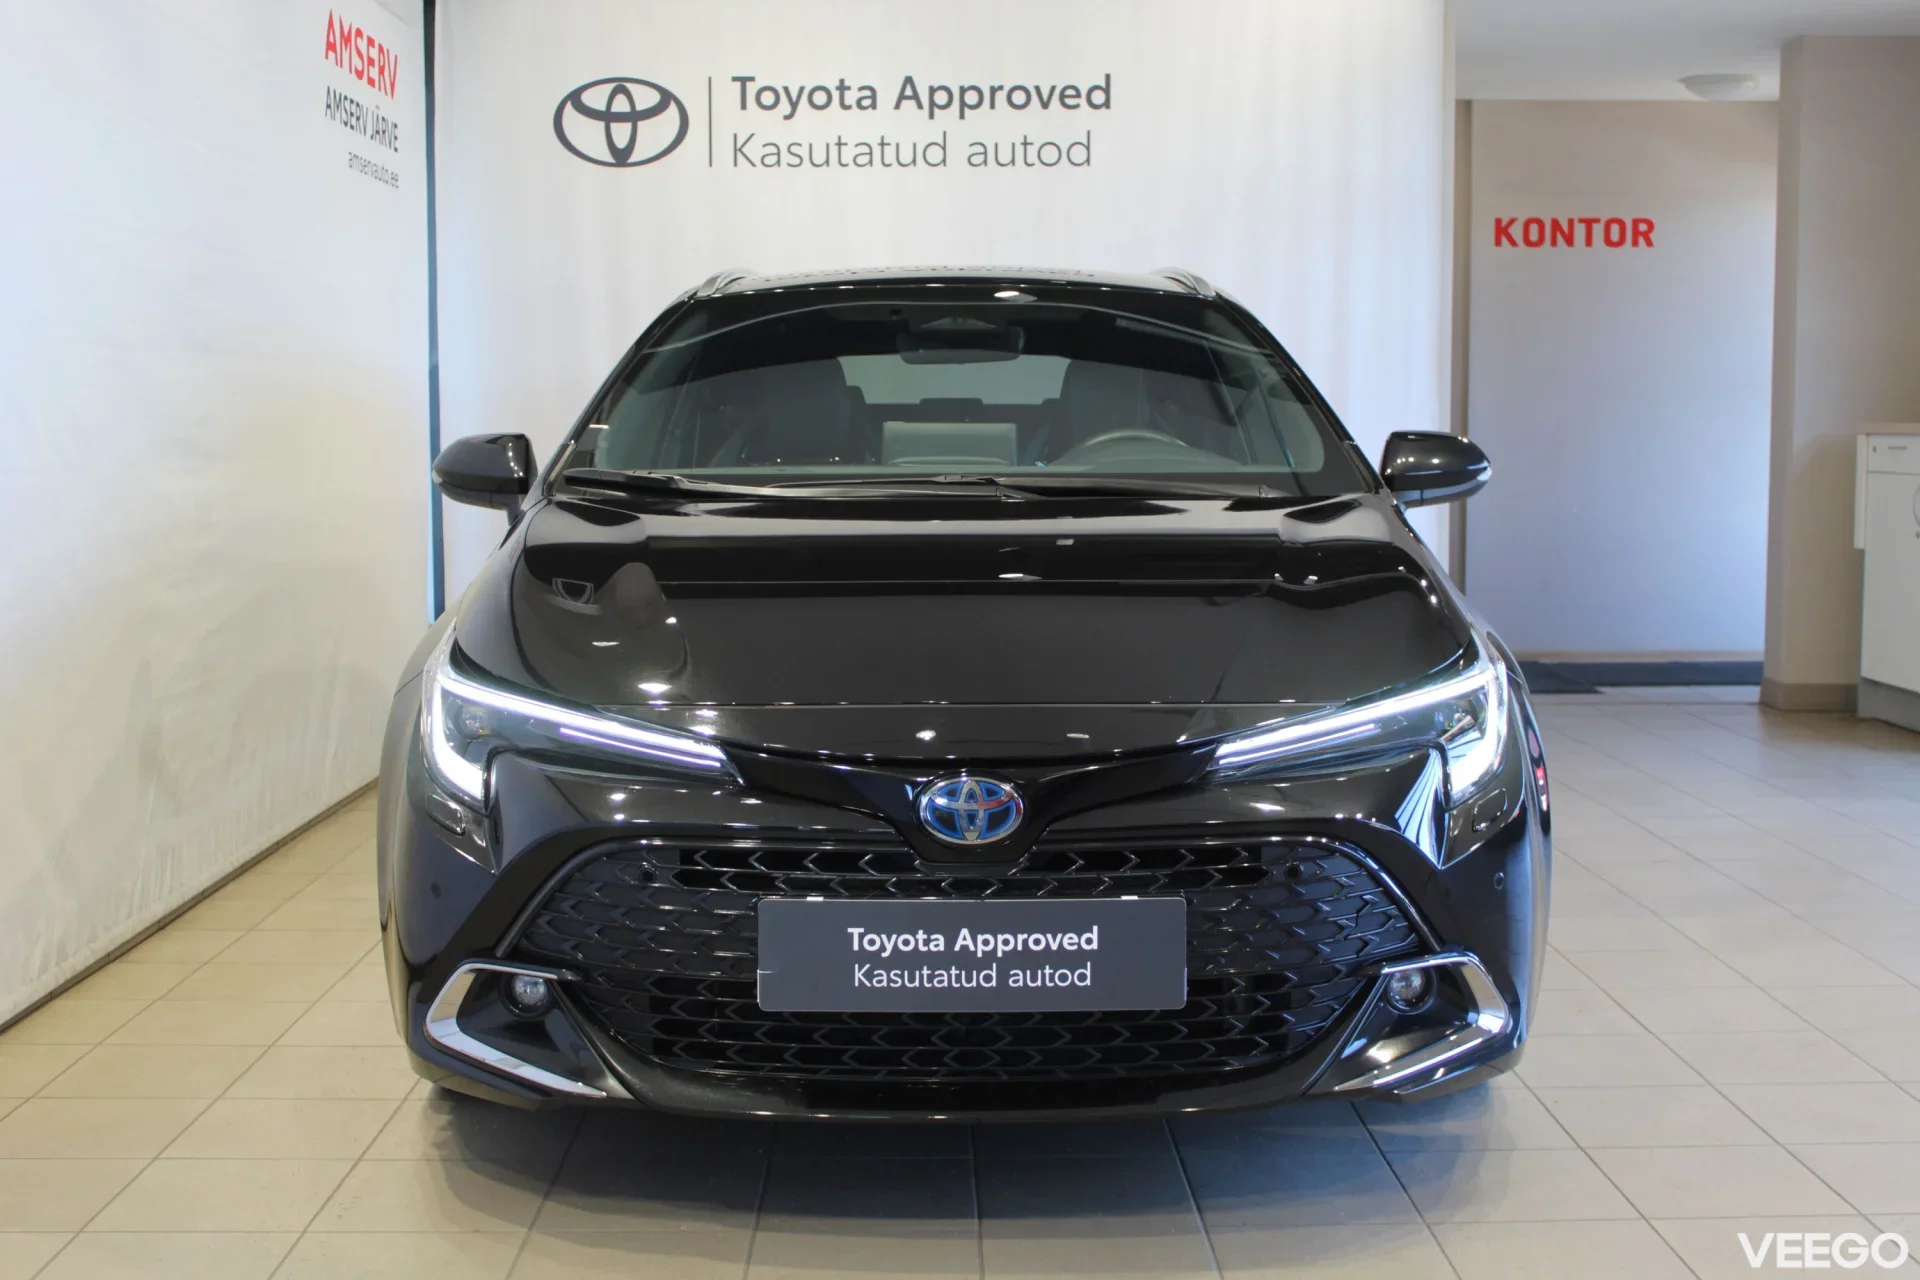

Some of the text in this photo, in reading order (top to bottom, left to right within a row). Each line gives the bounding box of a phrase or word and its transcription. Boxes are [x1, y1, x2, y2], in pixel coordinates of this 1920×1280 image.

[325, 8, 398, 100] AMSERV
[731, 74, 1112, 120] Toyota Approved
[325, 85, 398, 153] AMSERV JÄRVE
[733, 130, 1092, 168] Kasutatud autod
[348, 151, 399, 189] amservauto.ee
[1494, 217, 1656, 248] KONTOR
[847, 925, 1099, 957] Toyota Approved
[854, 961, 1092, 988] Kasutatud autod
